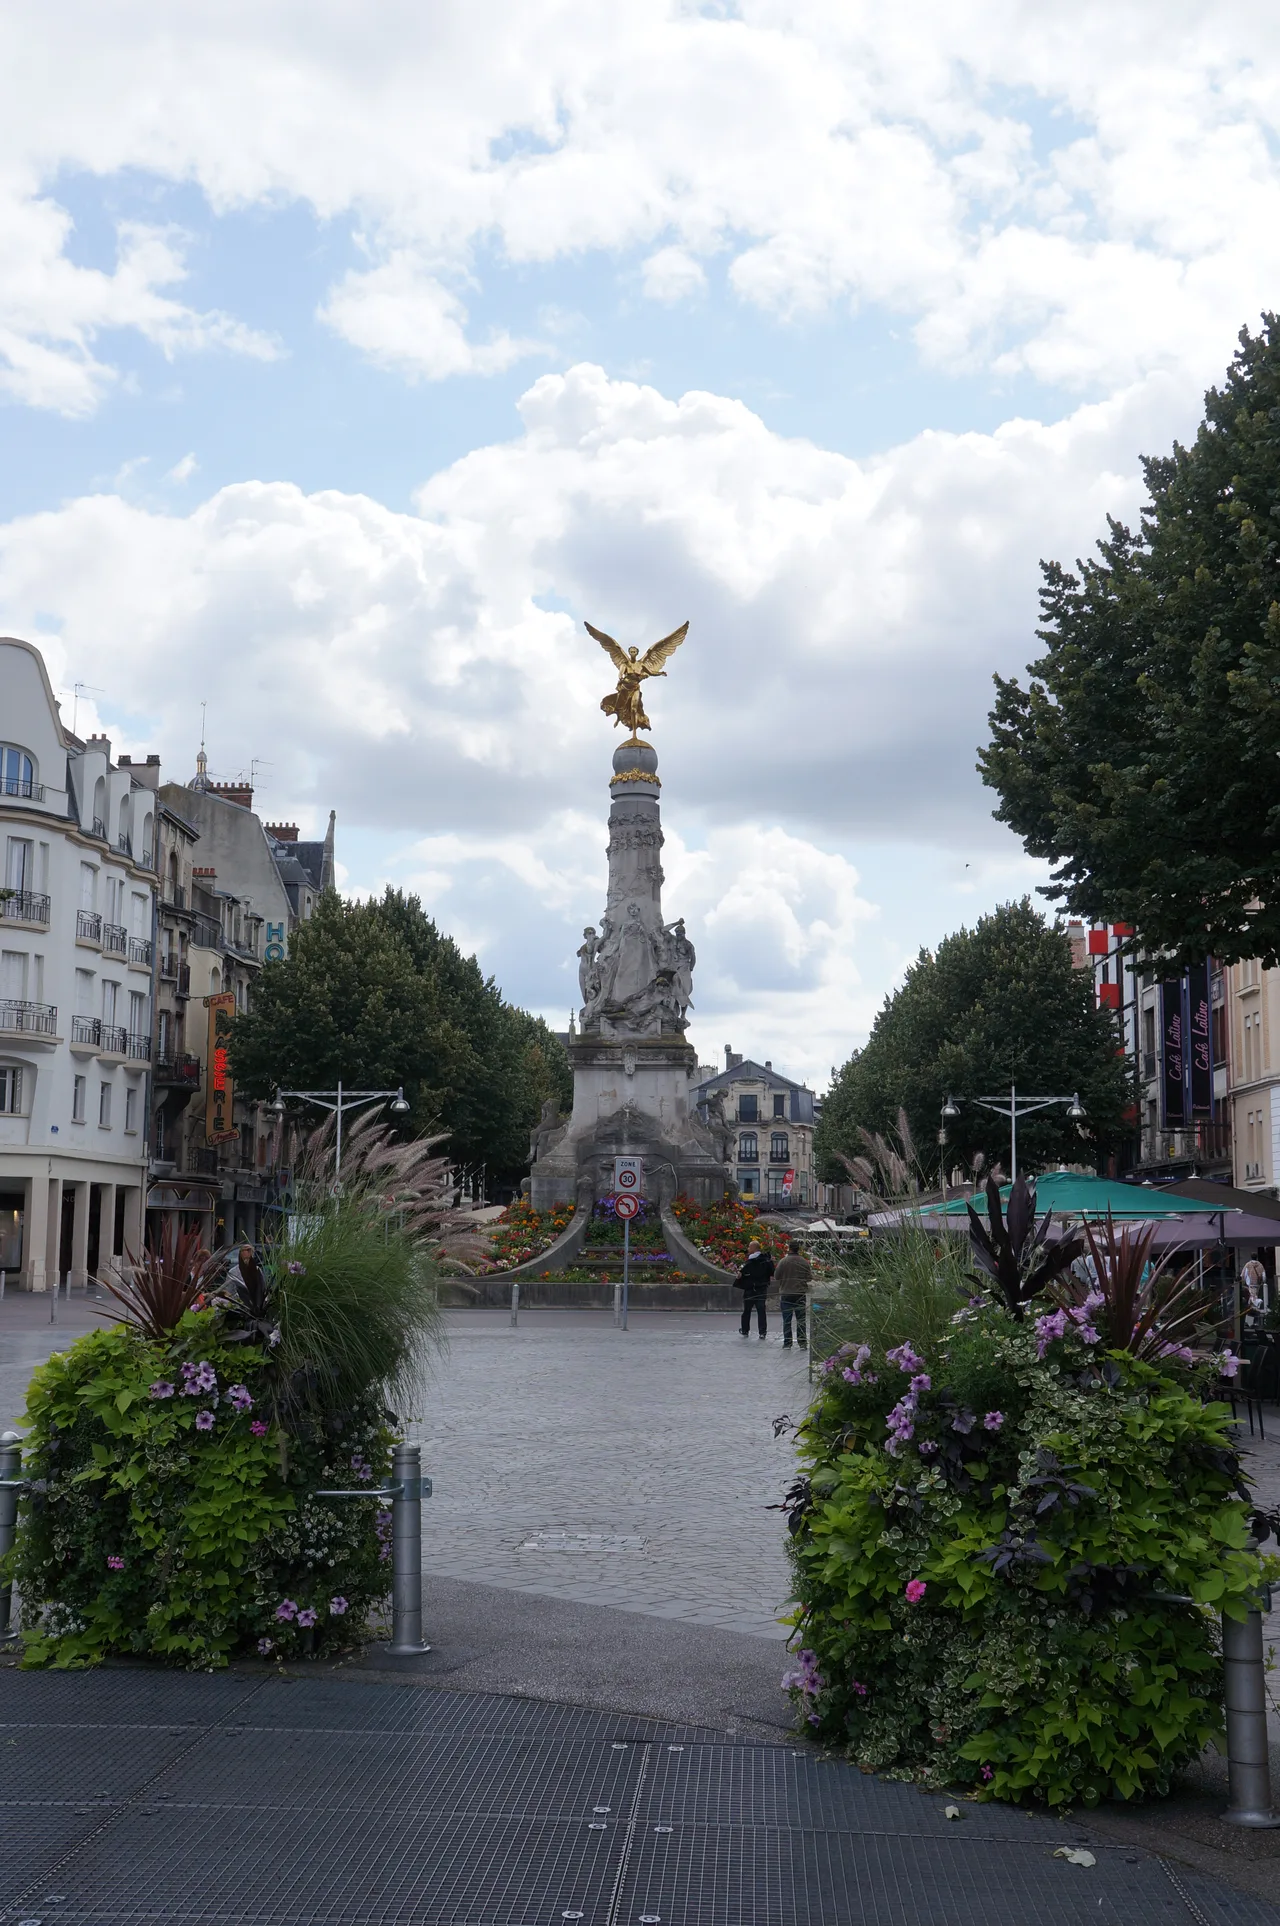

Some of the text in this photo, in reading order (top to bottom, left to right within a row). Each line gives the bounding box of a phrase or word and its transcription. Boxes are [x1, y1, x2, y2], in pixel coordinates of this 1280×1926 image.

[1165, 1013, 1182, 1081] Café Latino
[1192, 999, 1209, 1071] Café Latino
